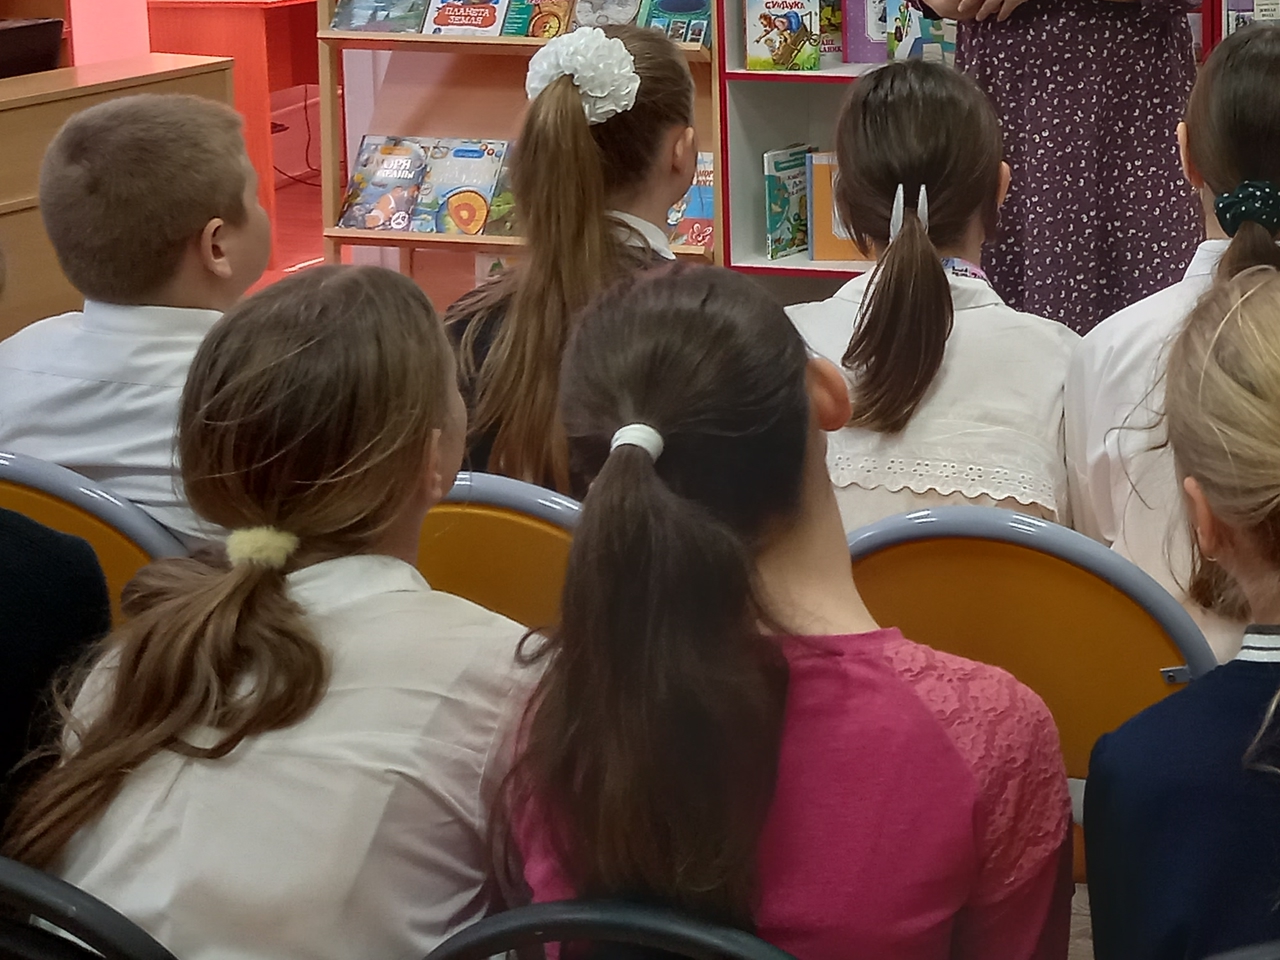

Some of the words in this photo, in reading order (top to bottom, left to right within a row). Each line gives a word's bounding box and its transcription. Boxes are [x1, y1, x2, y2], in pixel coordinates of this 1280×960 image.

[765, 1, 805, 10] СУНДУКА
[444, 6, 490, 17] ПЛАНЕТА
[448, 15, 483, 25] ЗЕМЛЯ
